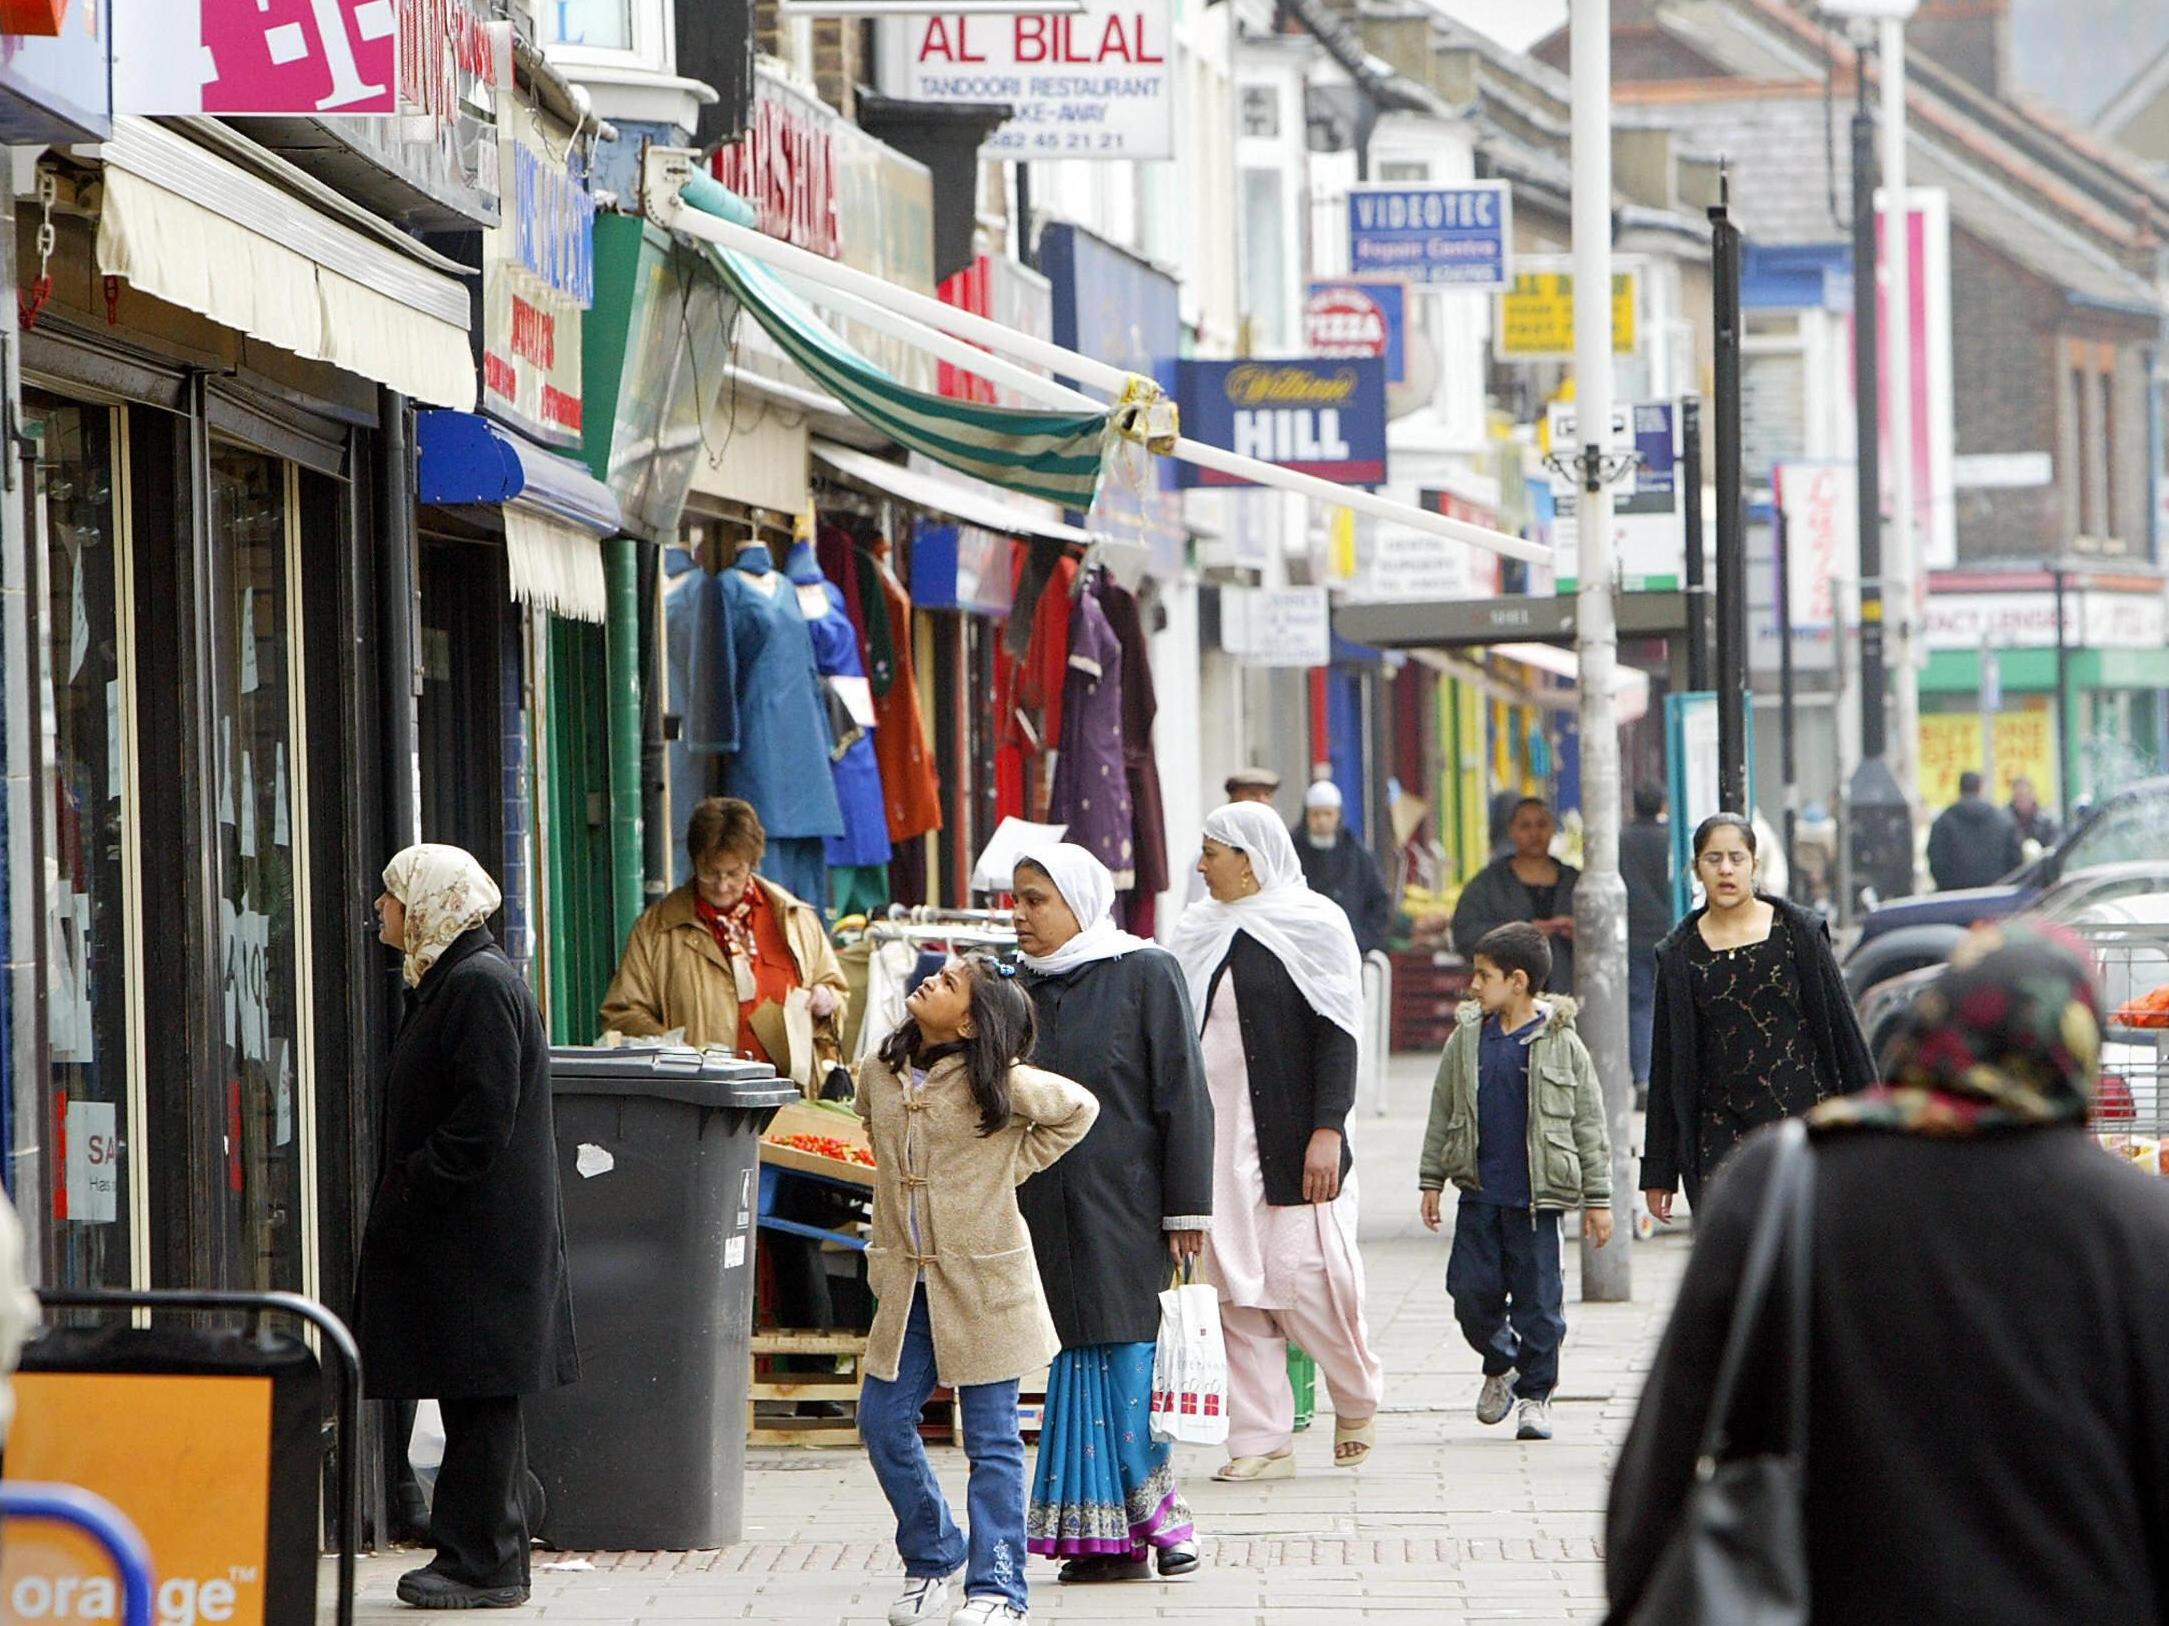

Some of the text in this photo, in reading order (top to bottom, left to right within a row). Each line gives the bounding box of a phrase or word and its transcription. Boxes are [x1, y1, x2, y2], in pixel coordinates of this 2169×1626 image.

[919, 14, 1163, 62] AL BILAL
[921, 77, 1160, 96] TANDOORI RESTAURANT
[1014, 103, 1107, 121] KE-AWAY
[1358, 192, 1493, 229] VIDEOTEC
[1234, 409, 1349, 460] HILL
[11, 1576, 236, 1626] orage
